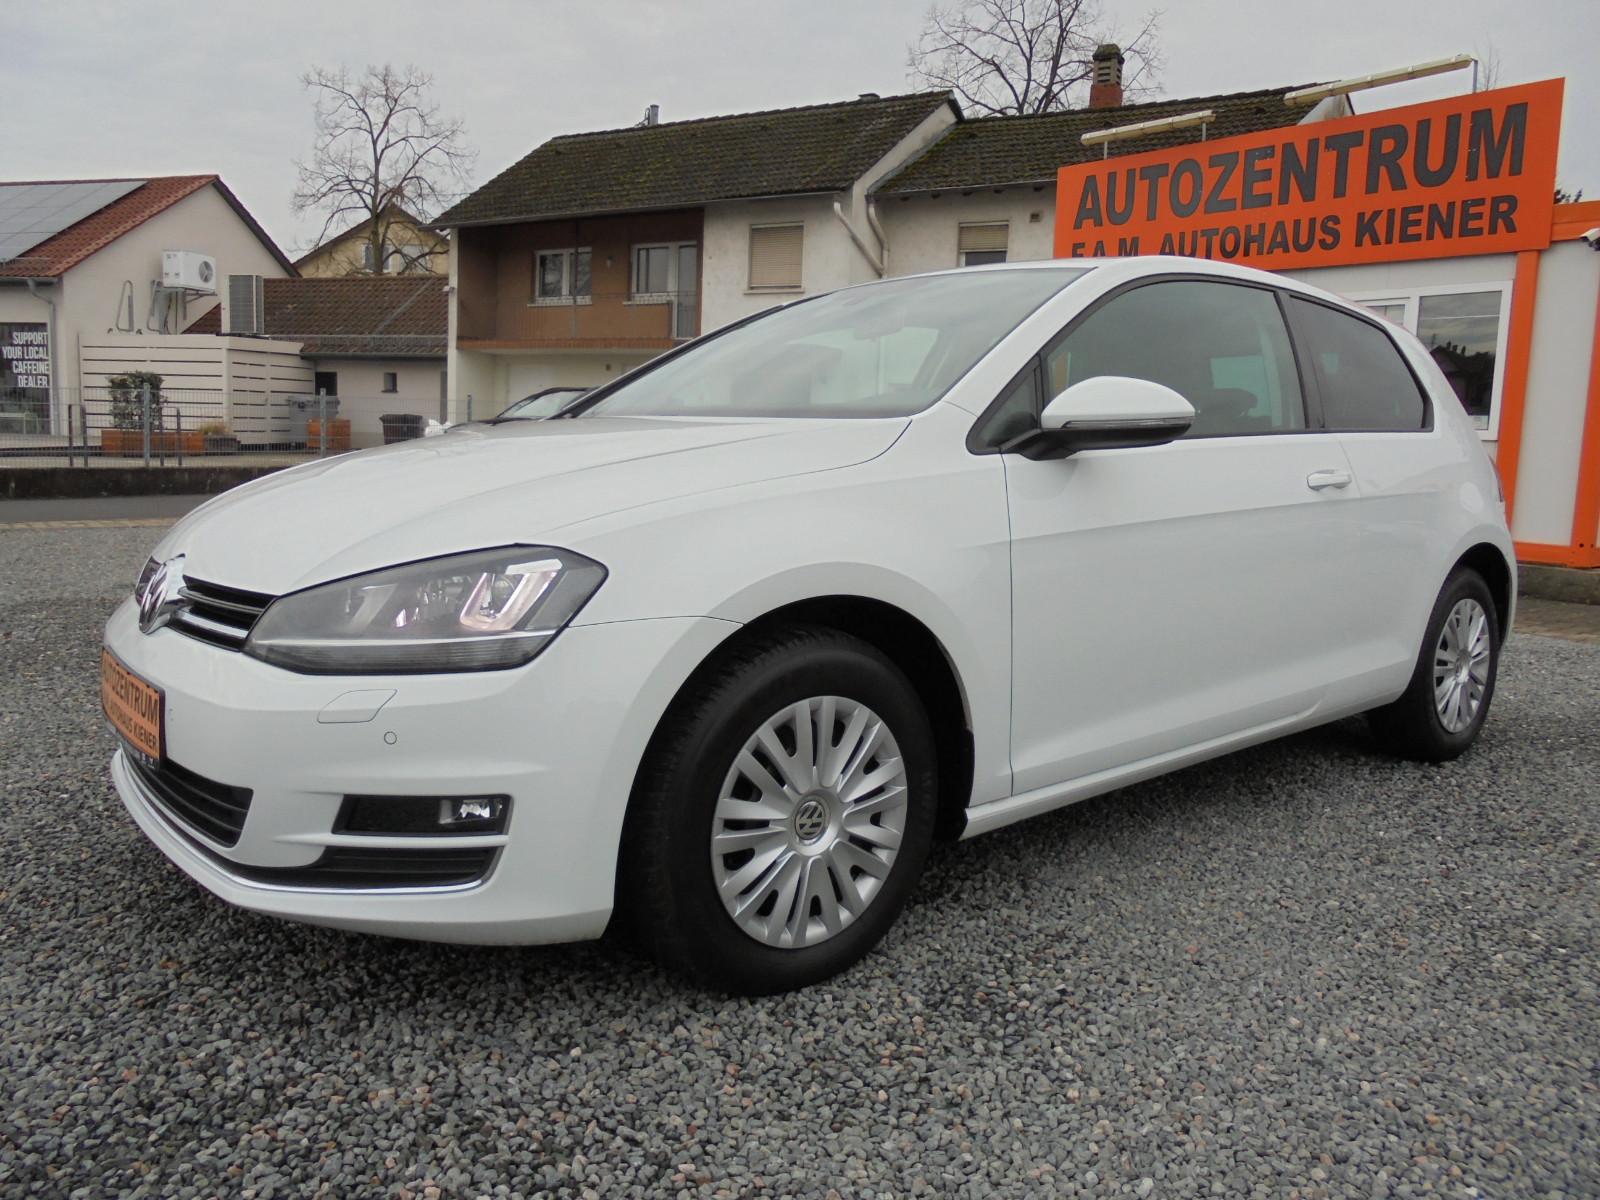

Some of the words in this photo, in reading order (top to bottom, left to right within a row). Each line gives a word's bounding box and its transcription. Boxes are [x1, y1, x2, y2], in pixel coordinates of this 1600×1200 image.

[1073, 102, 1529, 231] AUTOZENTRUM
[1159, 214, 1341, 260] AUTOHAUS
[1354, 194, 1518, 248] KIENER
[12, 331, 48, 345] SUPPORT
[2, 346, 23, 359] YOUR
[24, 346, 49, 360] LOCAL
[12, 360, 50, 374] CAFFEINE
[17, 375, 49, 388] DEALER
[134, 718, 157, 751] KIENER
